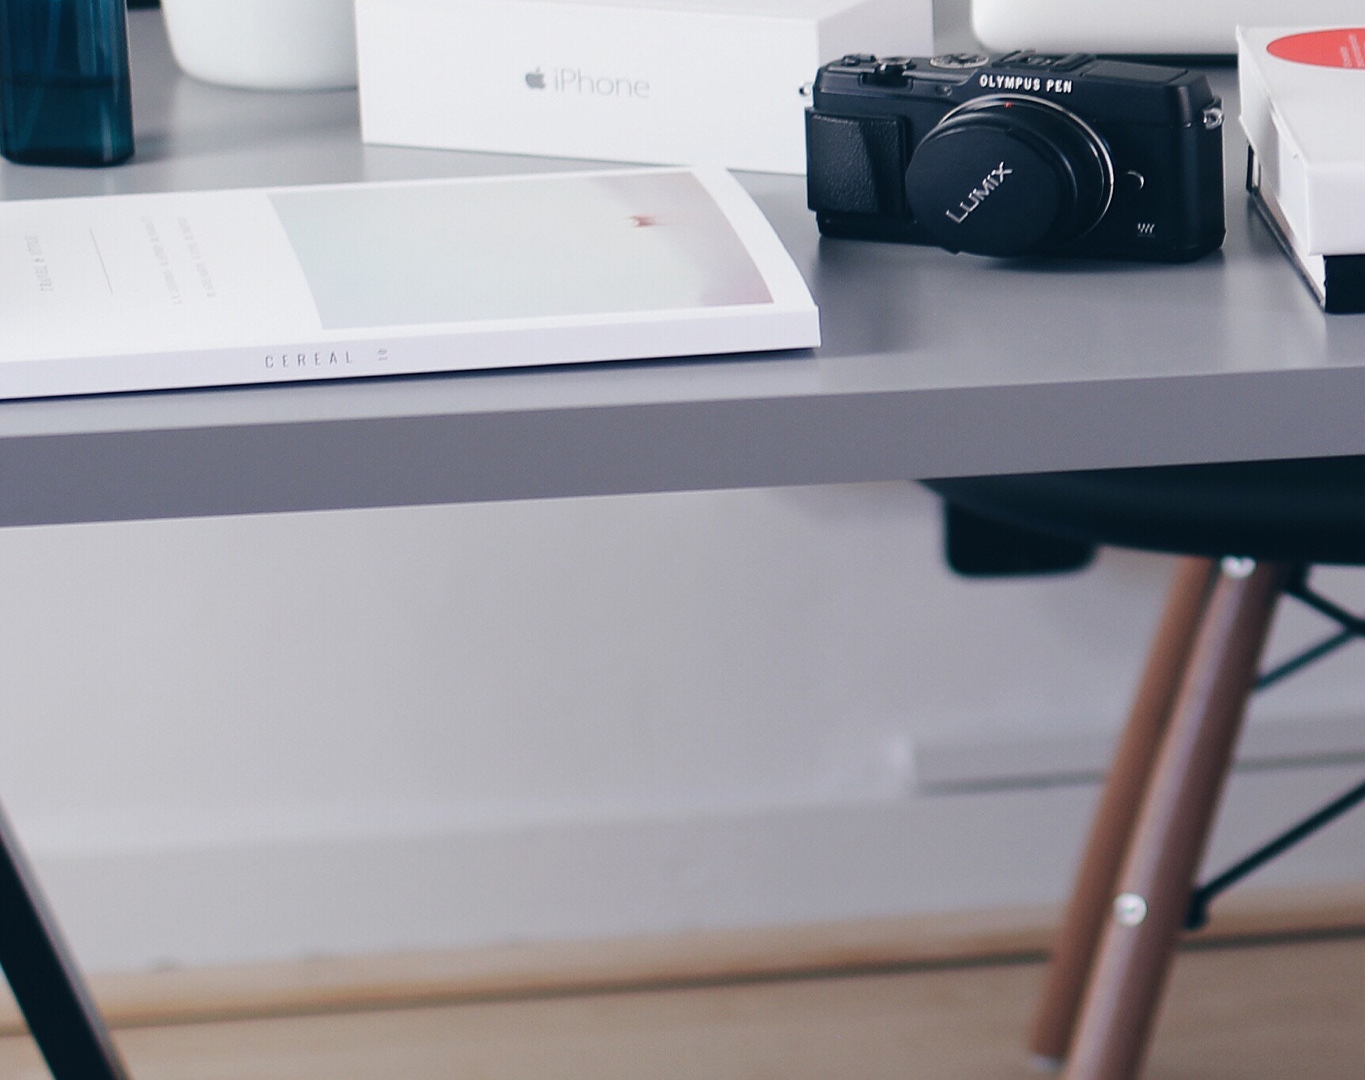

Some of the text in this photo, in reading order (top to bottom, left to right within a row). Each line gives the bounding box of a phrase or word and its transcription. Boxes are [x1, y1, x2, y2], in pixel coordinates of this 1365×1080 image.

[554, 67, 650, 98] iPhone
[979, 74, 1072, 93] OLYMPUS PEN
[946, 161, 1013, 224] LUMIX
[265, 351, 353, 368] CEREAL
